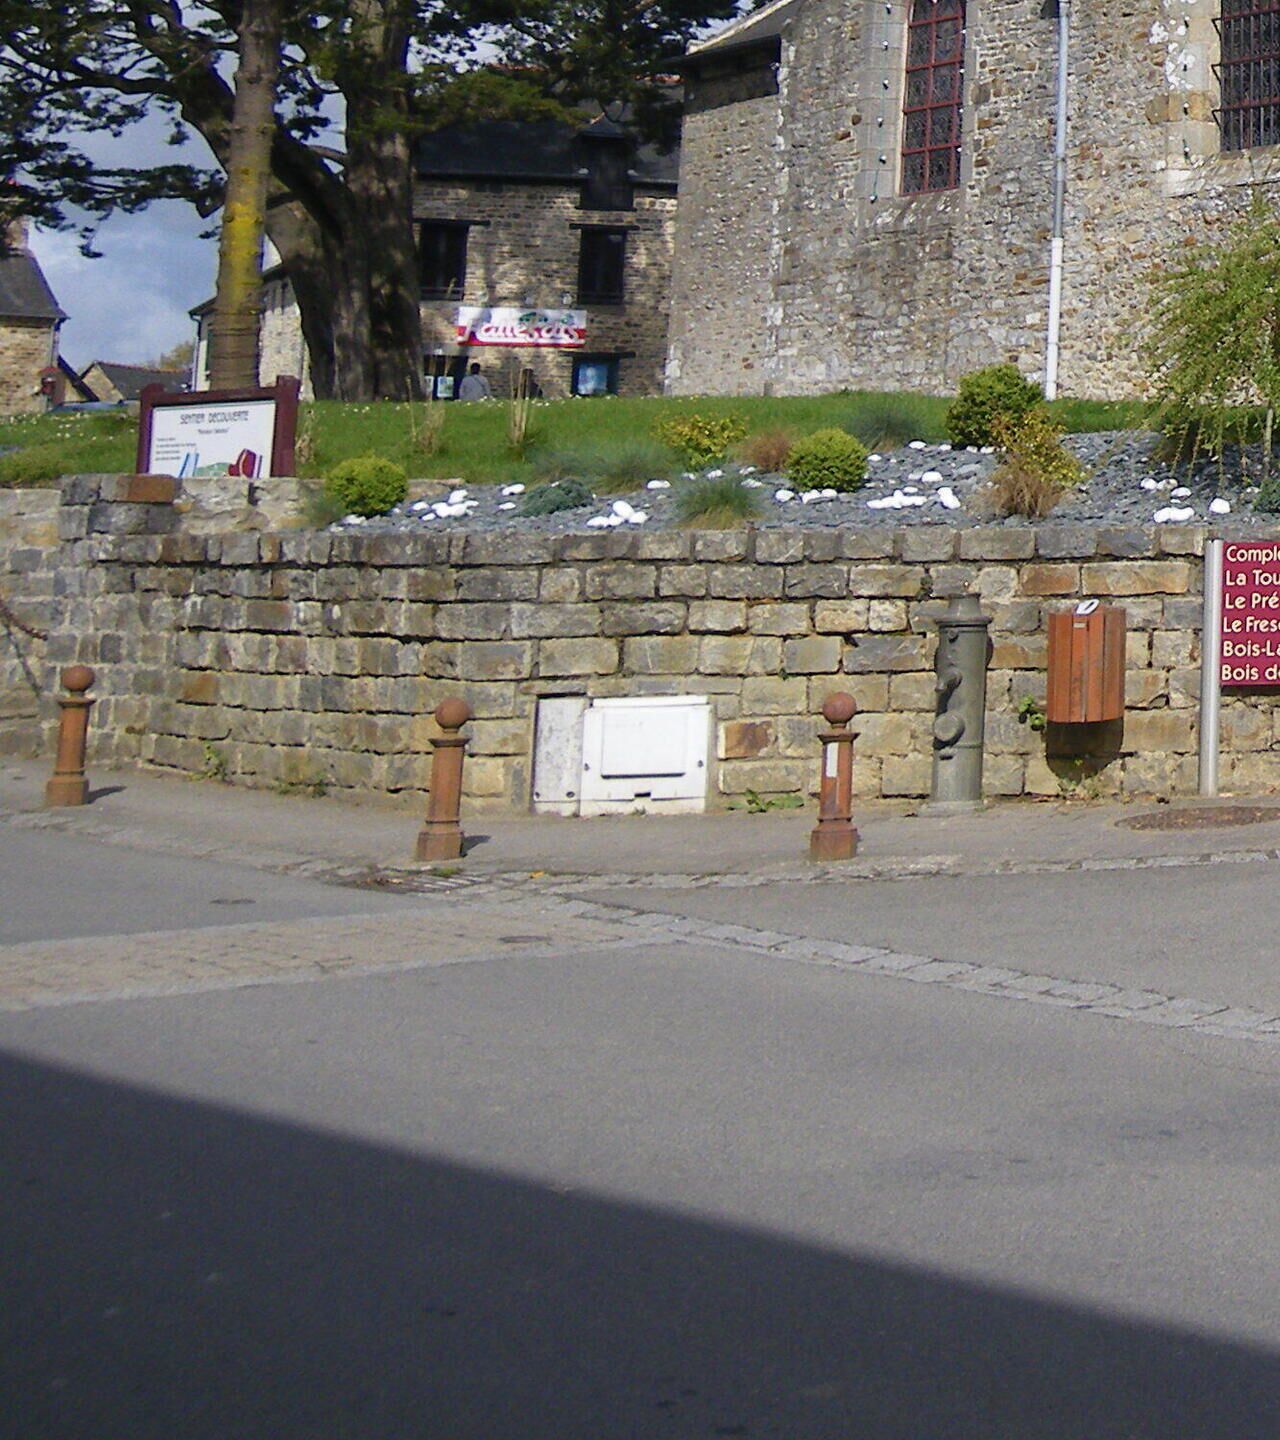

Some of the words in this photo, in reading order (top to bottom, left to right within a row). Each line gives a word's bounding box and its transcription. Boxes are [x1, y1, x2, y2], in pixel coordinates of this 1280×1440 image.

[1225, 570, 1246, 585] La
[1225, 593, 1246, 609] Le
[1251, 592, 1279, 608] Pré
[1223, 617, 1241, 632] Le
[1221, 664, 1259, 681] Bois
